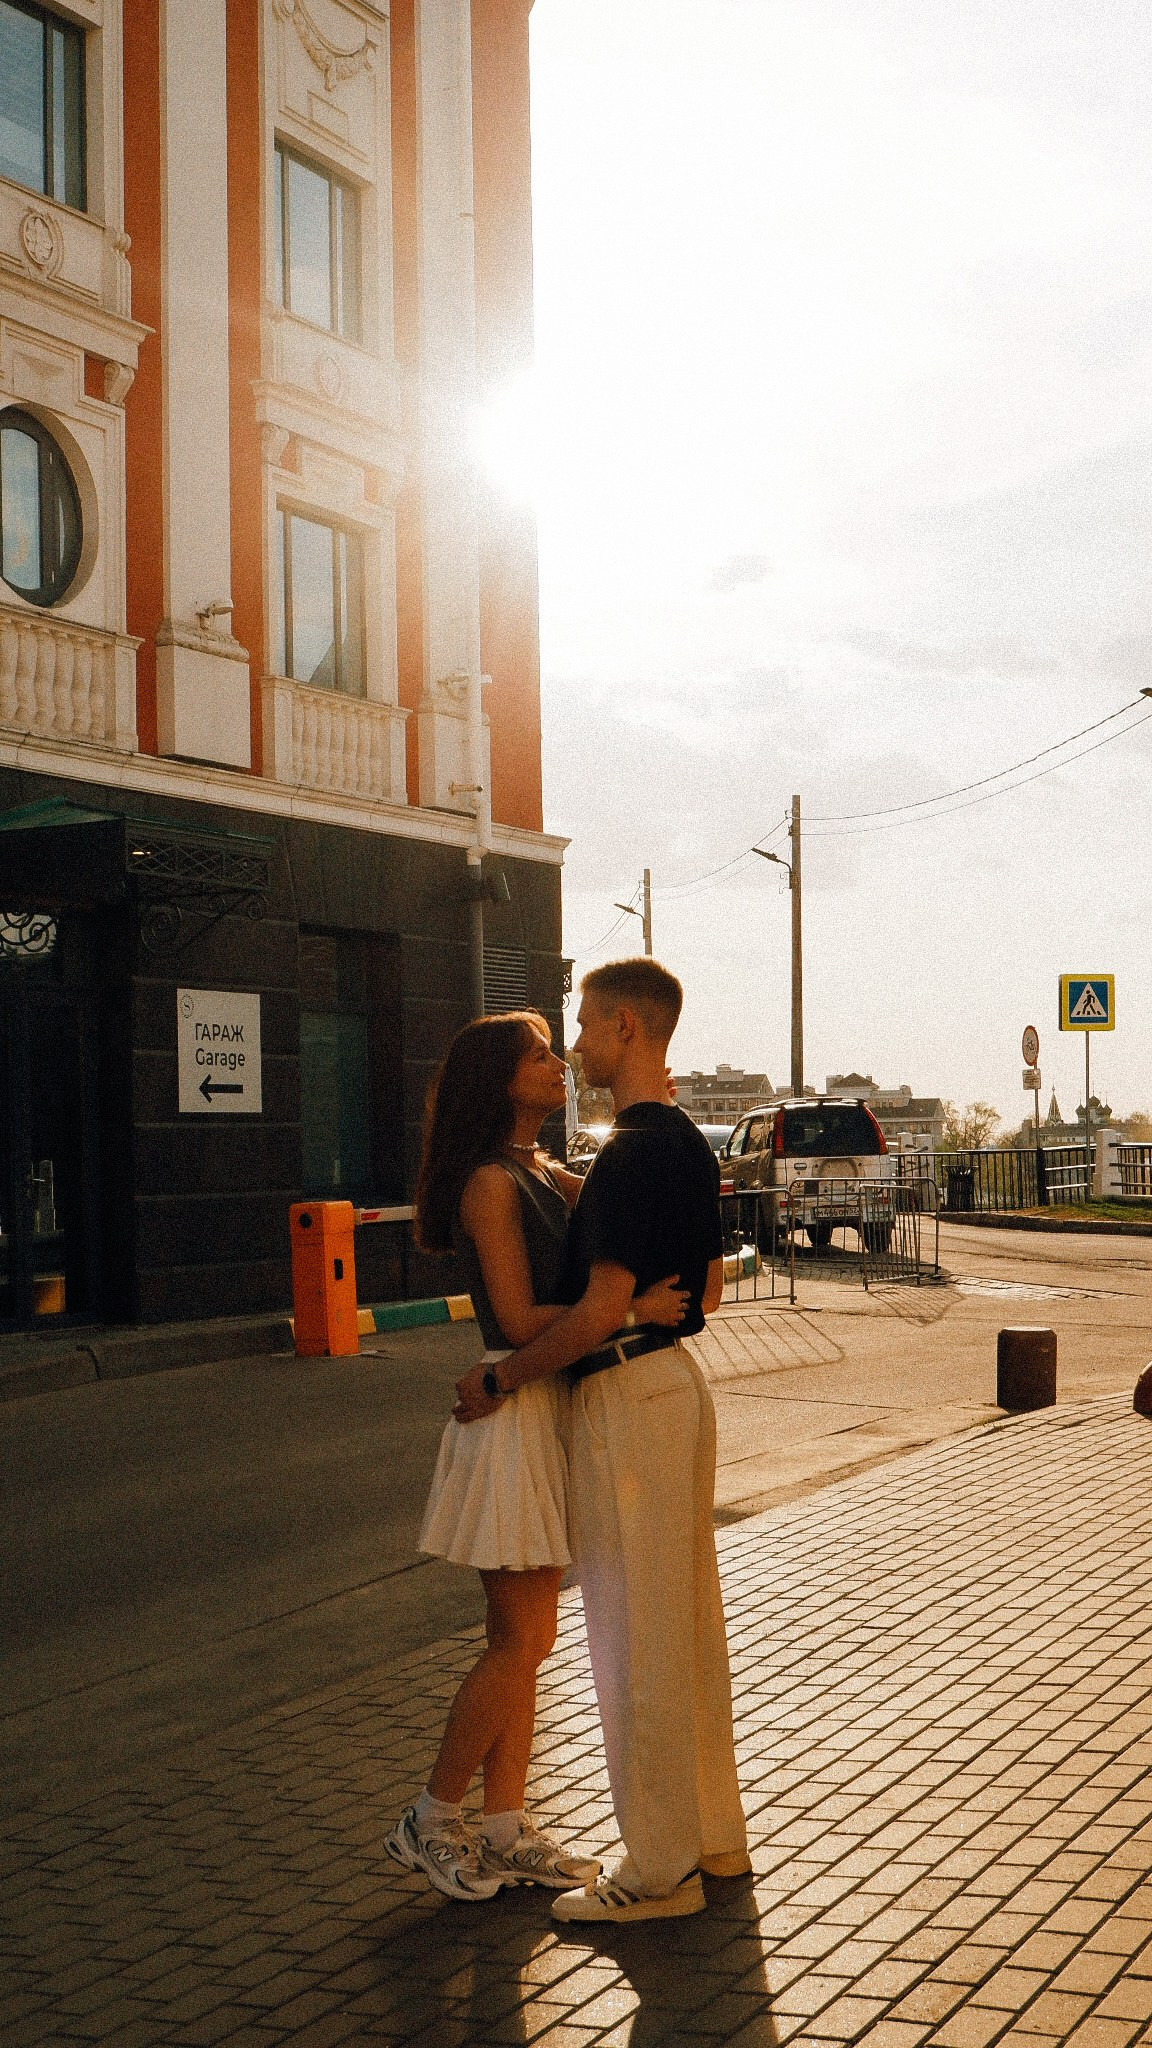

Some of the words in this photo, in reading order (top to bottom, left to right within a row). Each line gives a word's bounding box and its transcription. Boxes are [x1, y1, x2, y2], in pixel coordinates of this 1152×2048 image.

[195, 1023, 244, 1042] ГАРАЖ
[195, 1048, 246, 1071] Garage
[433, 1847, 453, 1863] N
[522, 1850, 545, 1867] N
